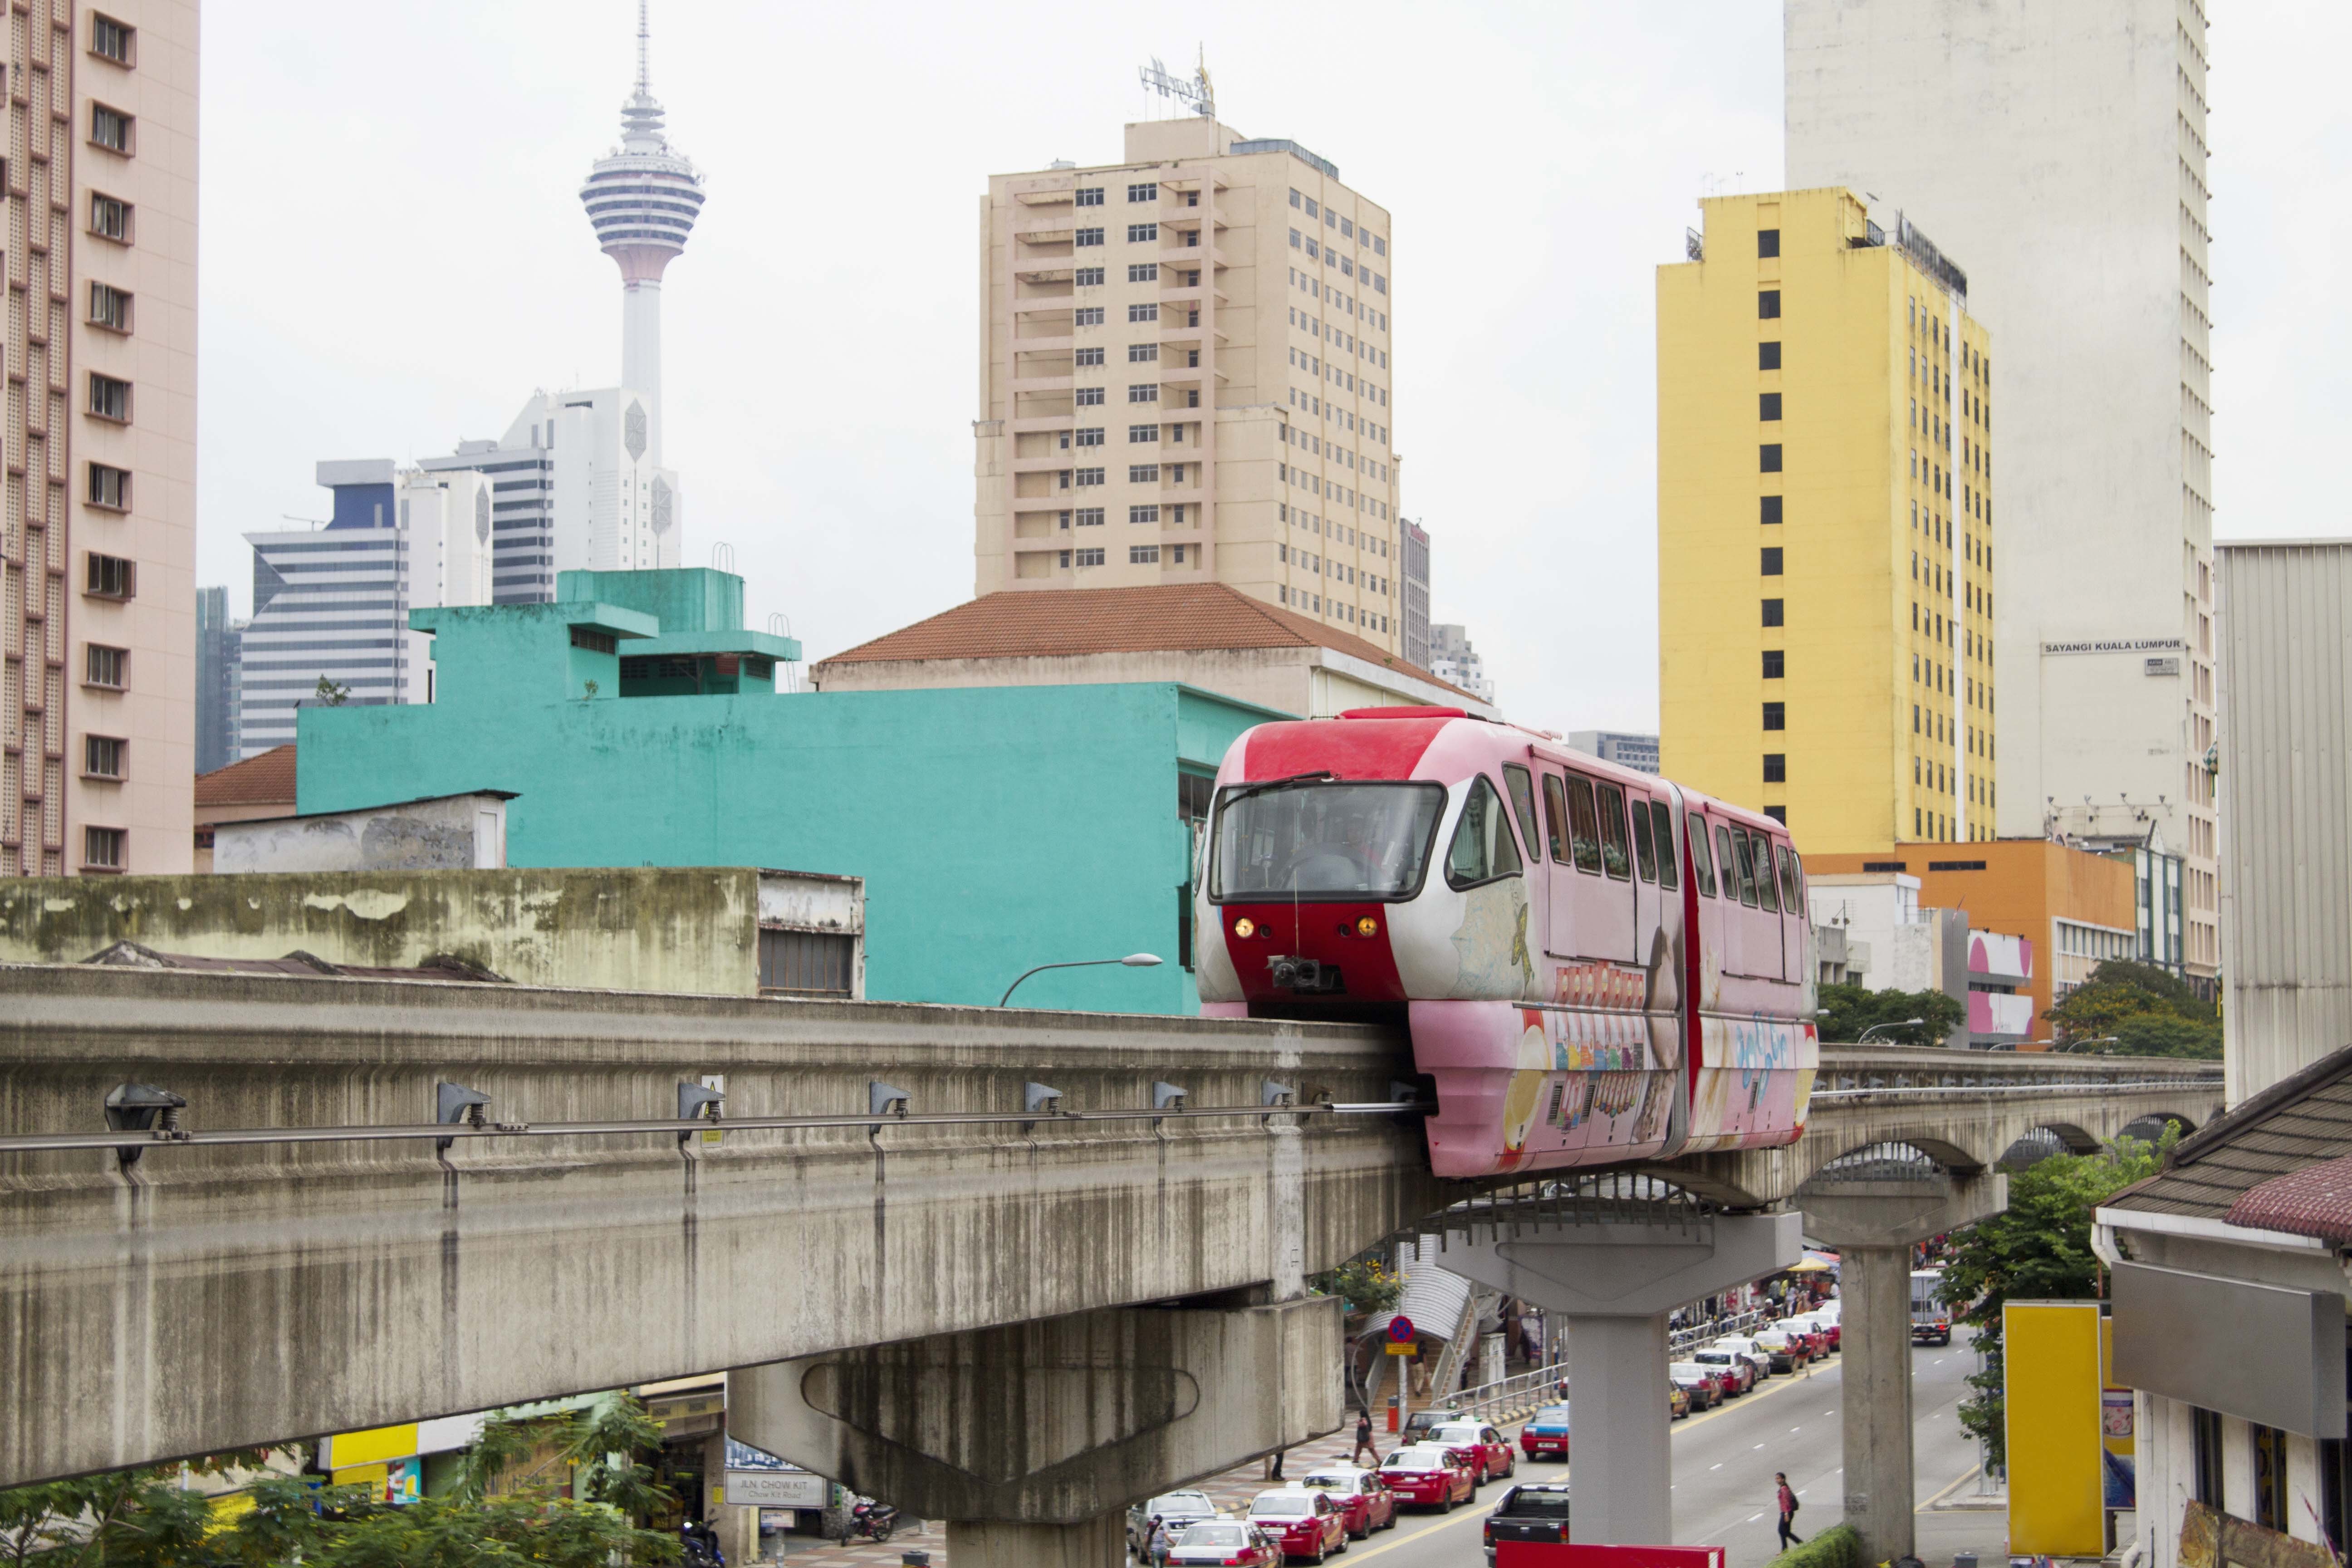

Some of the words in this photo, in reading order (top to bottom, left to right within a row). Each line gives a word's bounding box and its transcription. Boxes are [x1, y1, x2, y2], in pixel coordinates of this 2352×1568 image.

[2045, 643, 2091, 652] SAYANGI
[2095, 642, 2132, 650] KUALA
[2135, 640, 2180, 649] LUMPUR
[761, 1480, 791, 1489] CHOW
[794, 1481, 808, 1490] KIT
